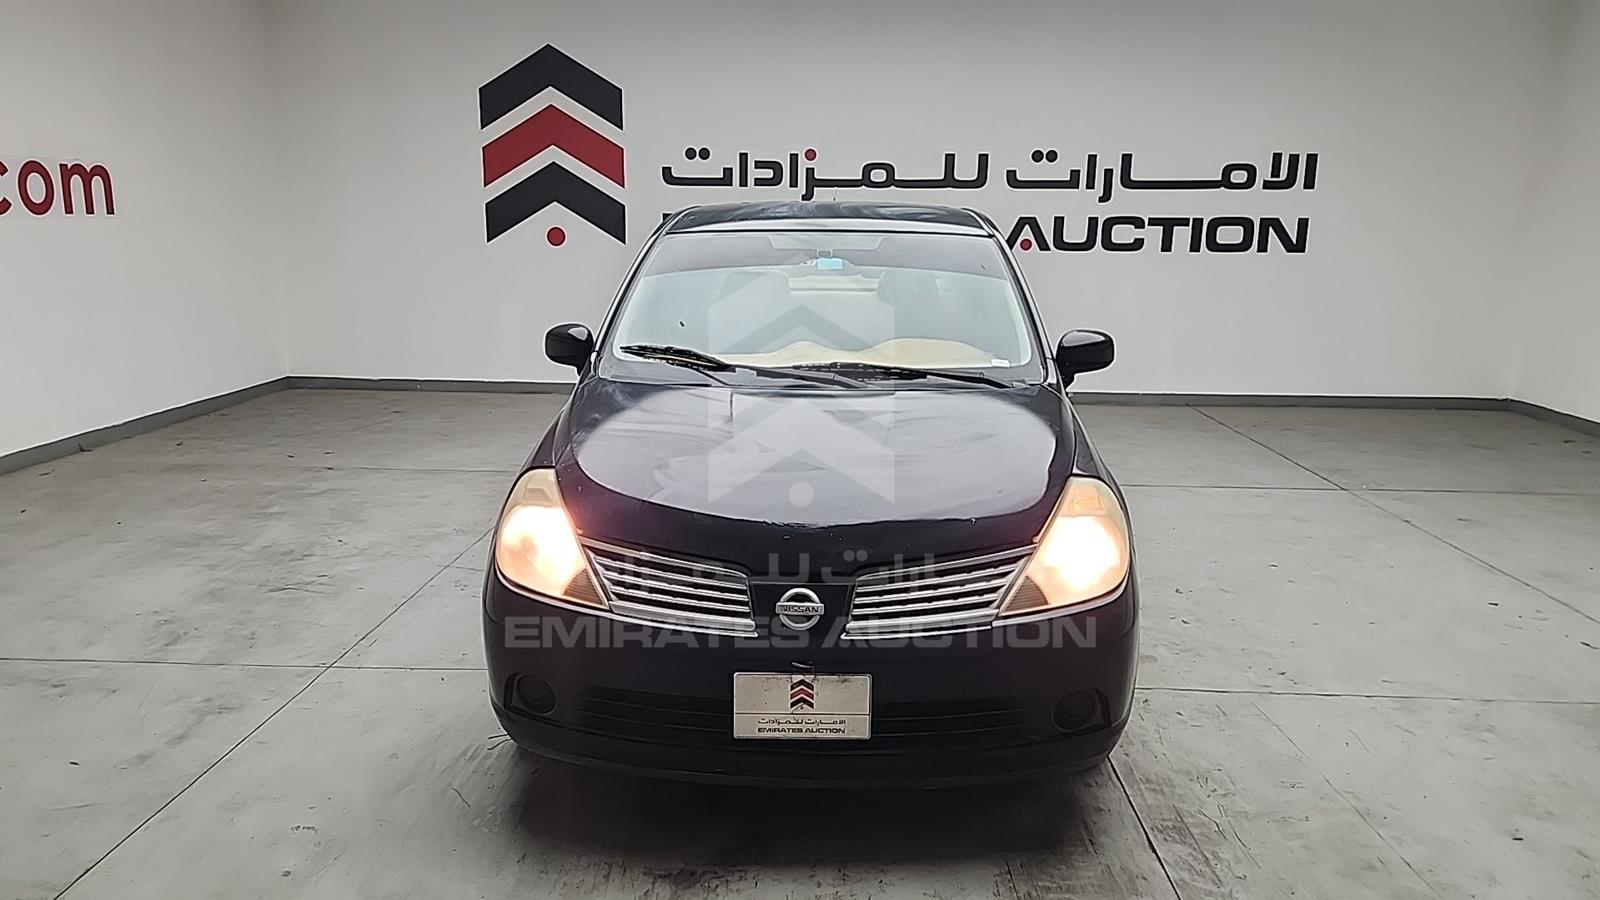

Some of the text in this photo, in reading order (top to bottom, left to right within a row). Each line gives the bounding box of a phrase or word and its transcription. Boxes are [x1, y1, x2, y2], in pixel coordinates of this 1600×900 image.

[661, 148, 1318, 203] الامارات للمزادات
[1005, 216, 1309, 253] AUCTION
[779, 605, 820, 613] NISSAN
